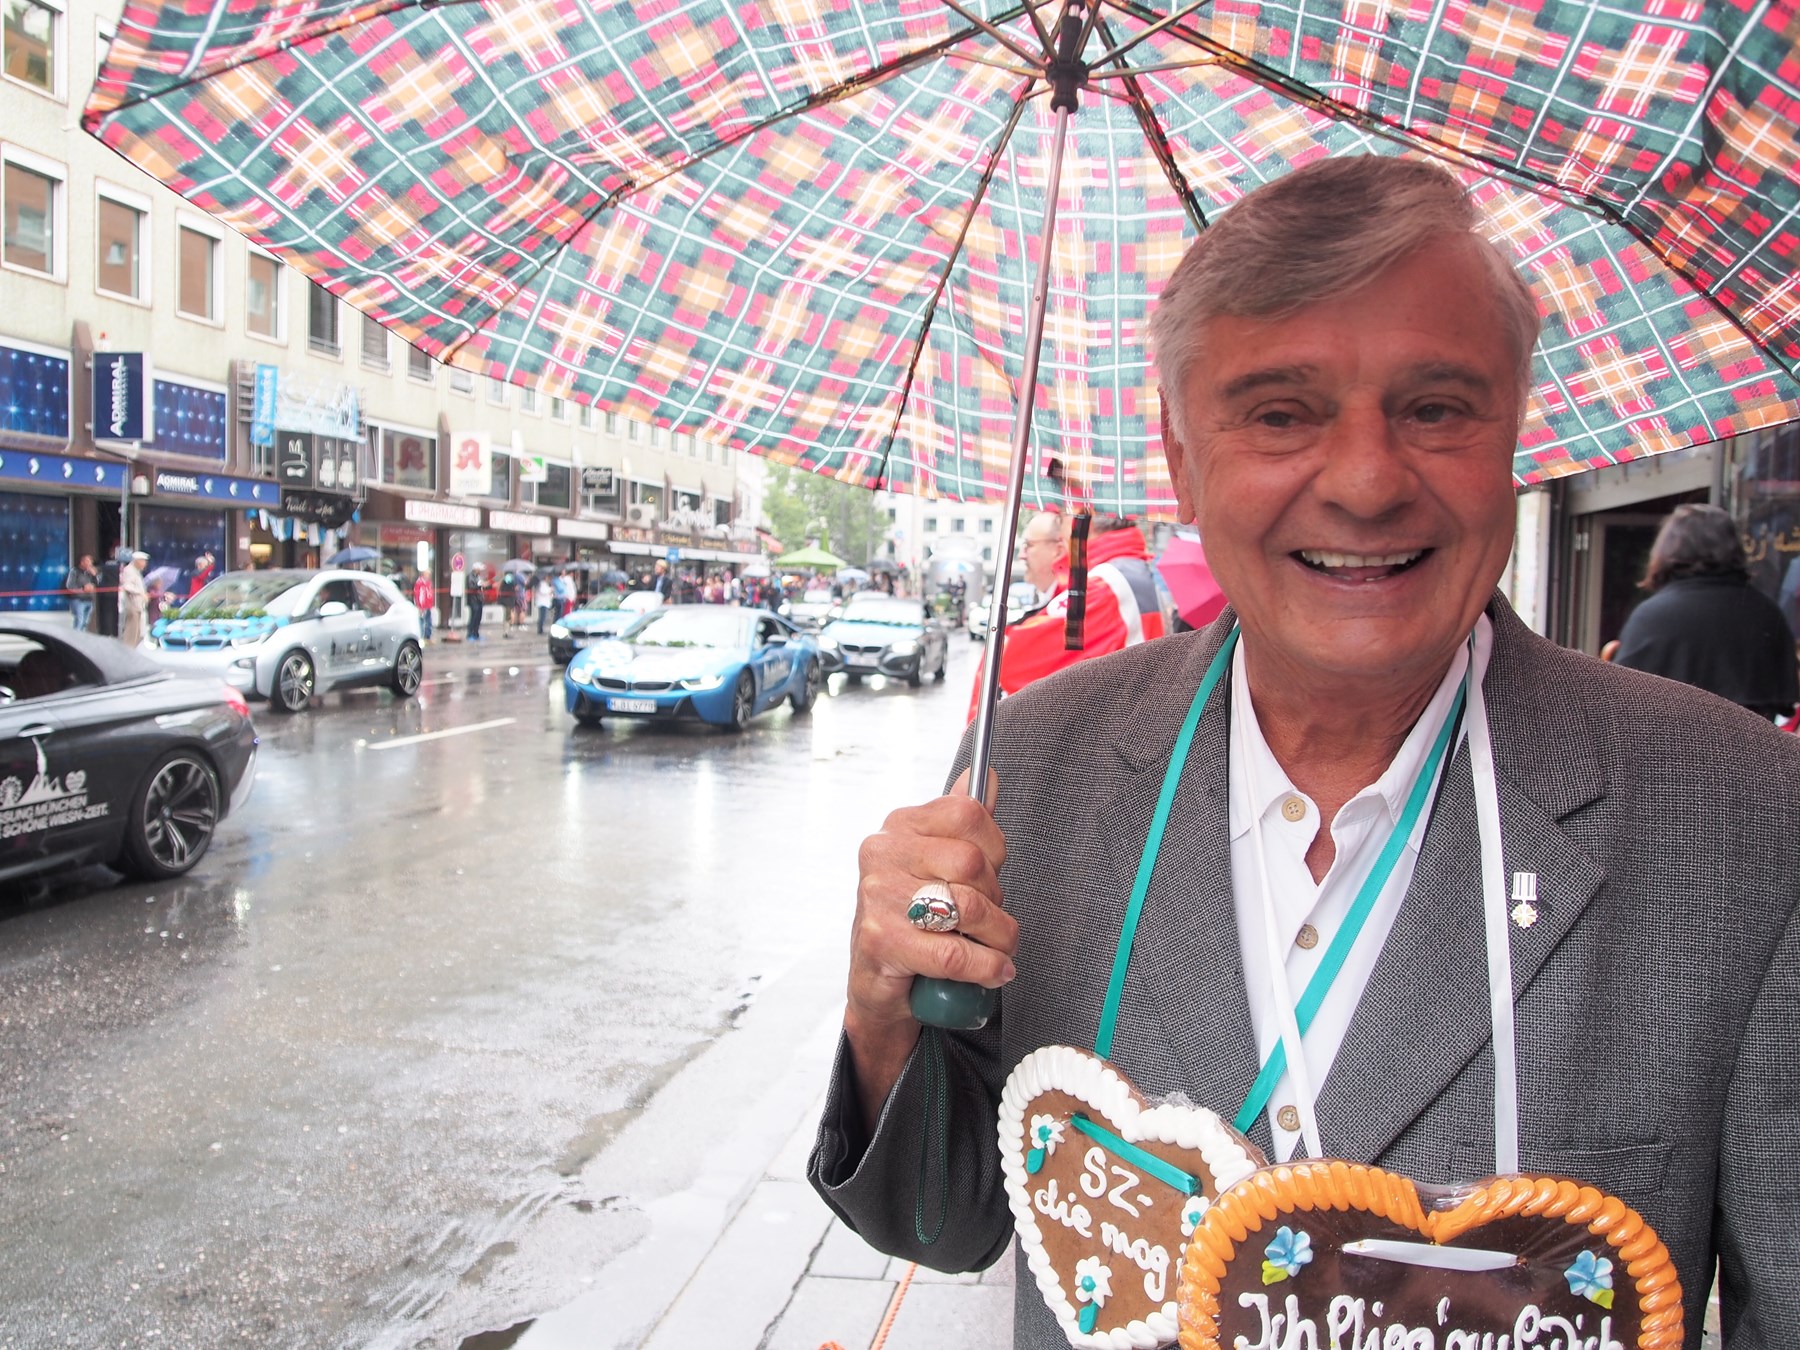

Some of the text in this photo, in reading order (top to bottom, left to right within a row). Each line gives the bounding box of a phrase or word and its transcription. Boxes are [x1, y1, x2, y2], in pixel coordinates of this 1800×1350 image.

[109, 354, 125, 437] ADMIRAL
[156, 472, 199, 491] ADMIRAL
[1034, 1179, 1093, 1238] die
[1080, 1147, 1153, 1218] SZ-
[1100, 1222, 1171, 1302] mog
